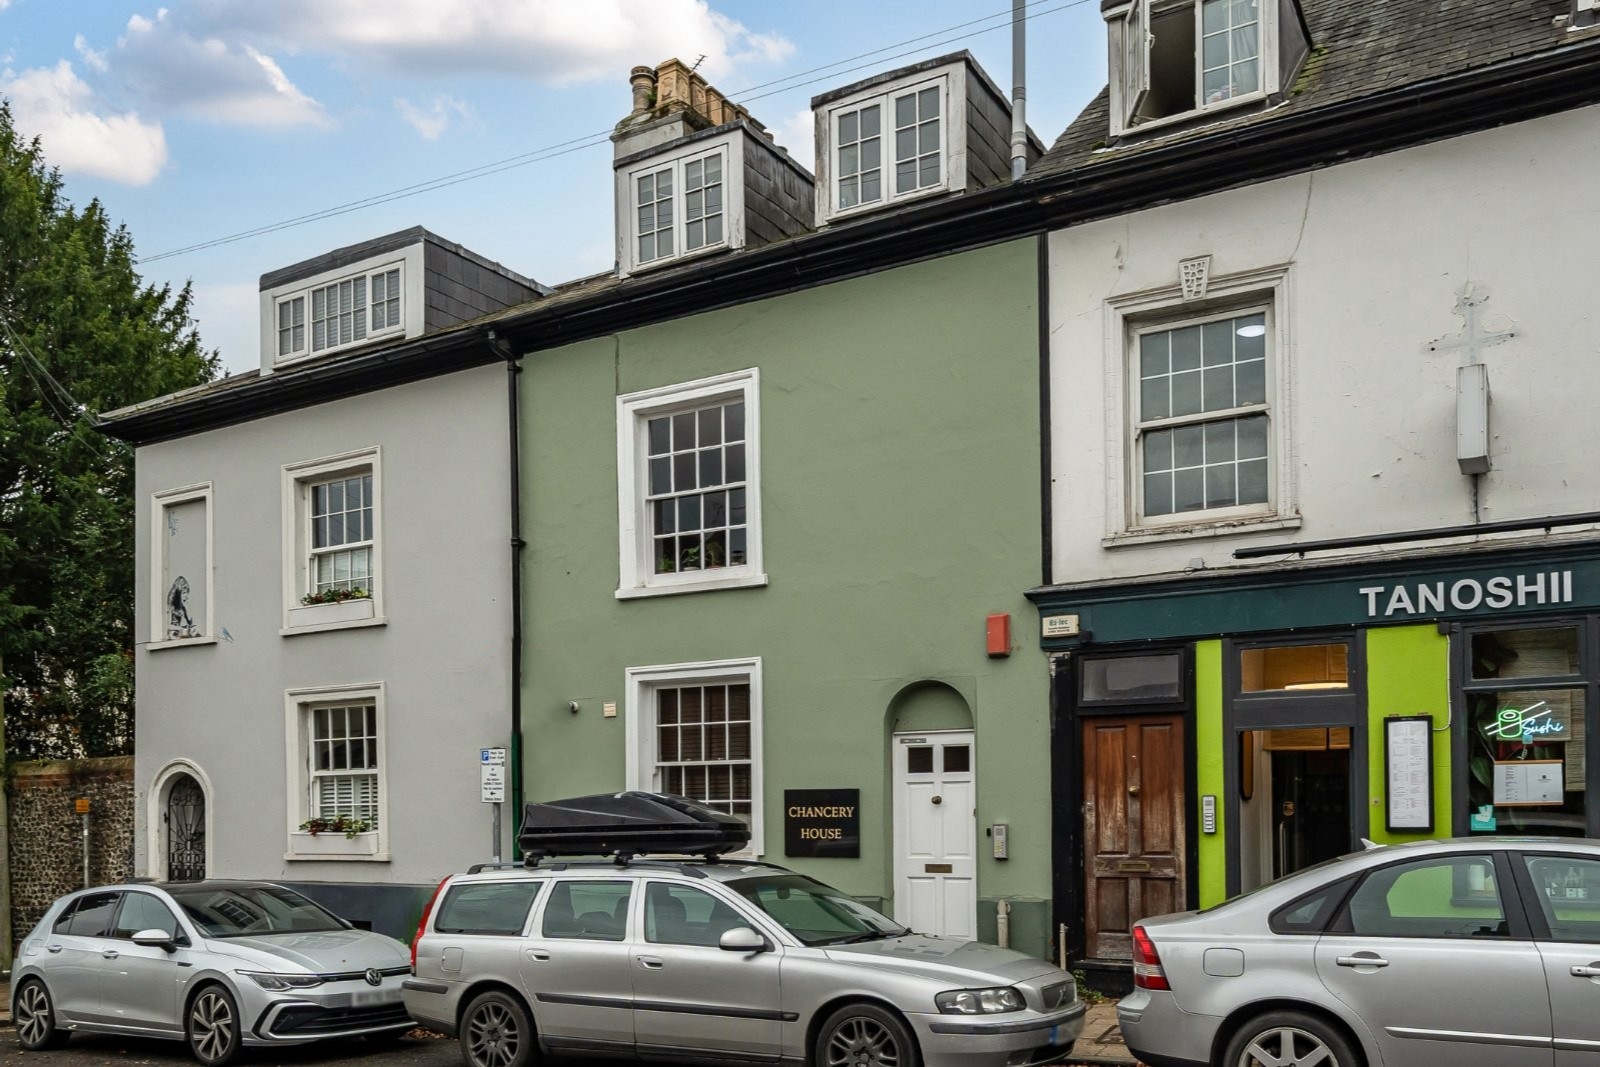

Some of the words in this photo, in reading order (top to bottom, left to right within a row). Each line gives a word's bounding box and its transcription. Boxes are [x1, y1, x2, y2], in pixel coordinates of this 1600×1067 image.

[1359, 570, 1572, 616] TANOSHII
[1521, 718, 1563, 735] Sushi
[788, 806, 854, 818] CHANCERY
[801, 828, 842, 839] HOUSE
